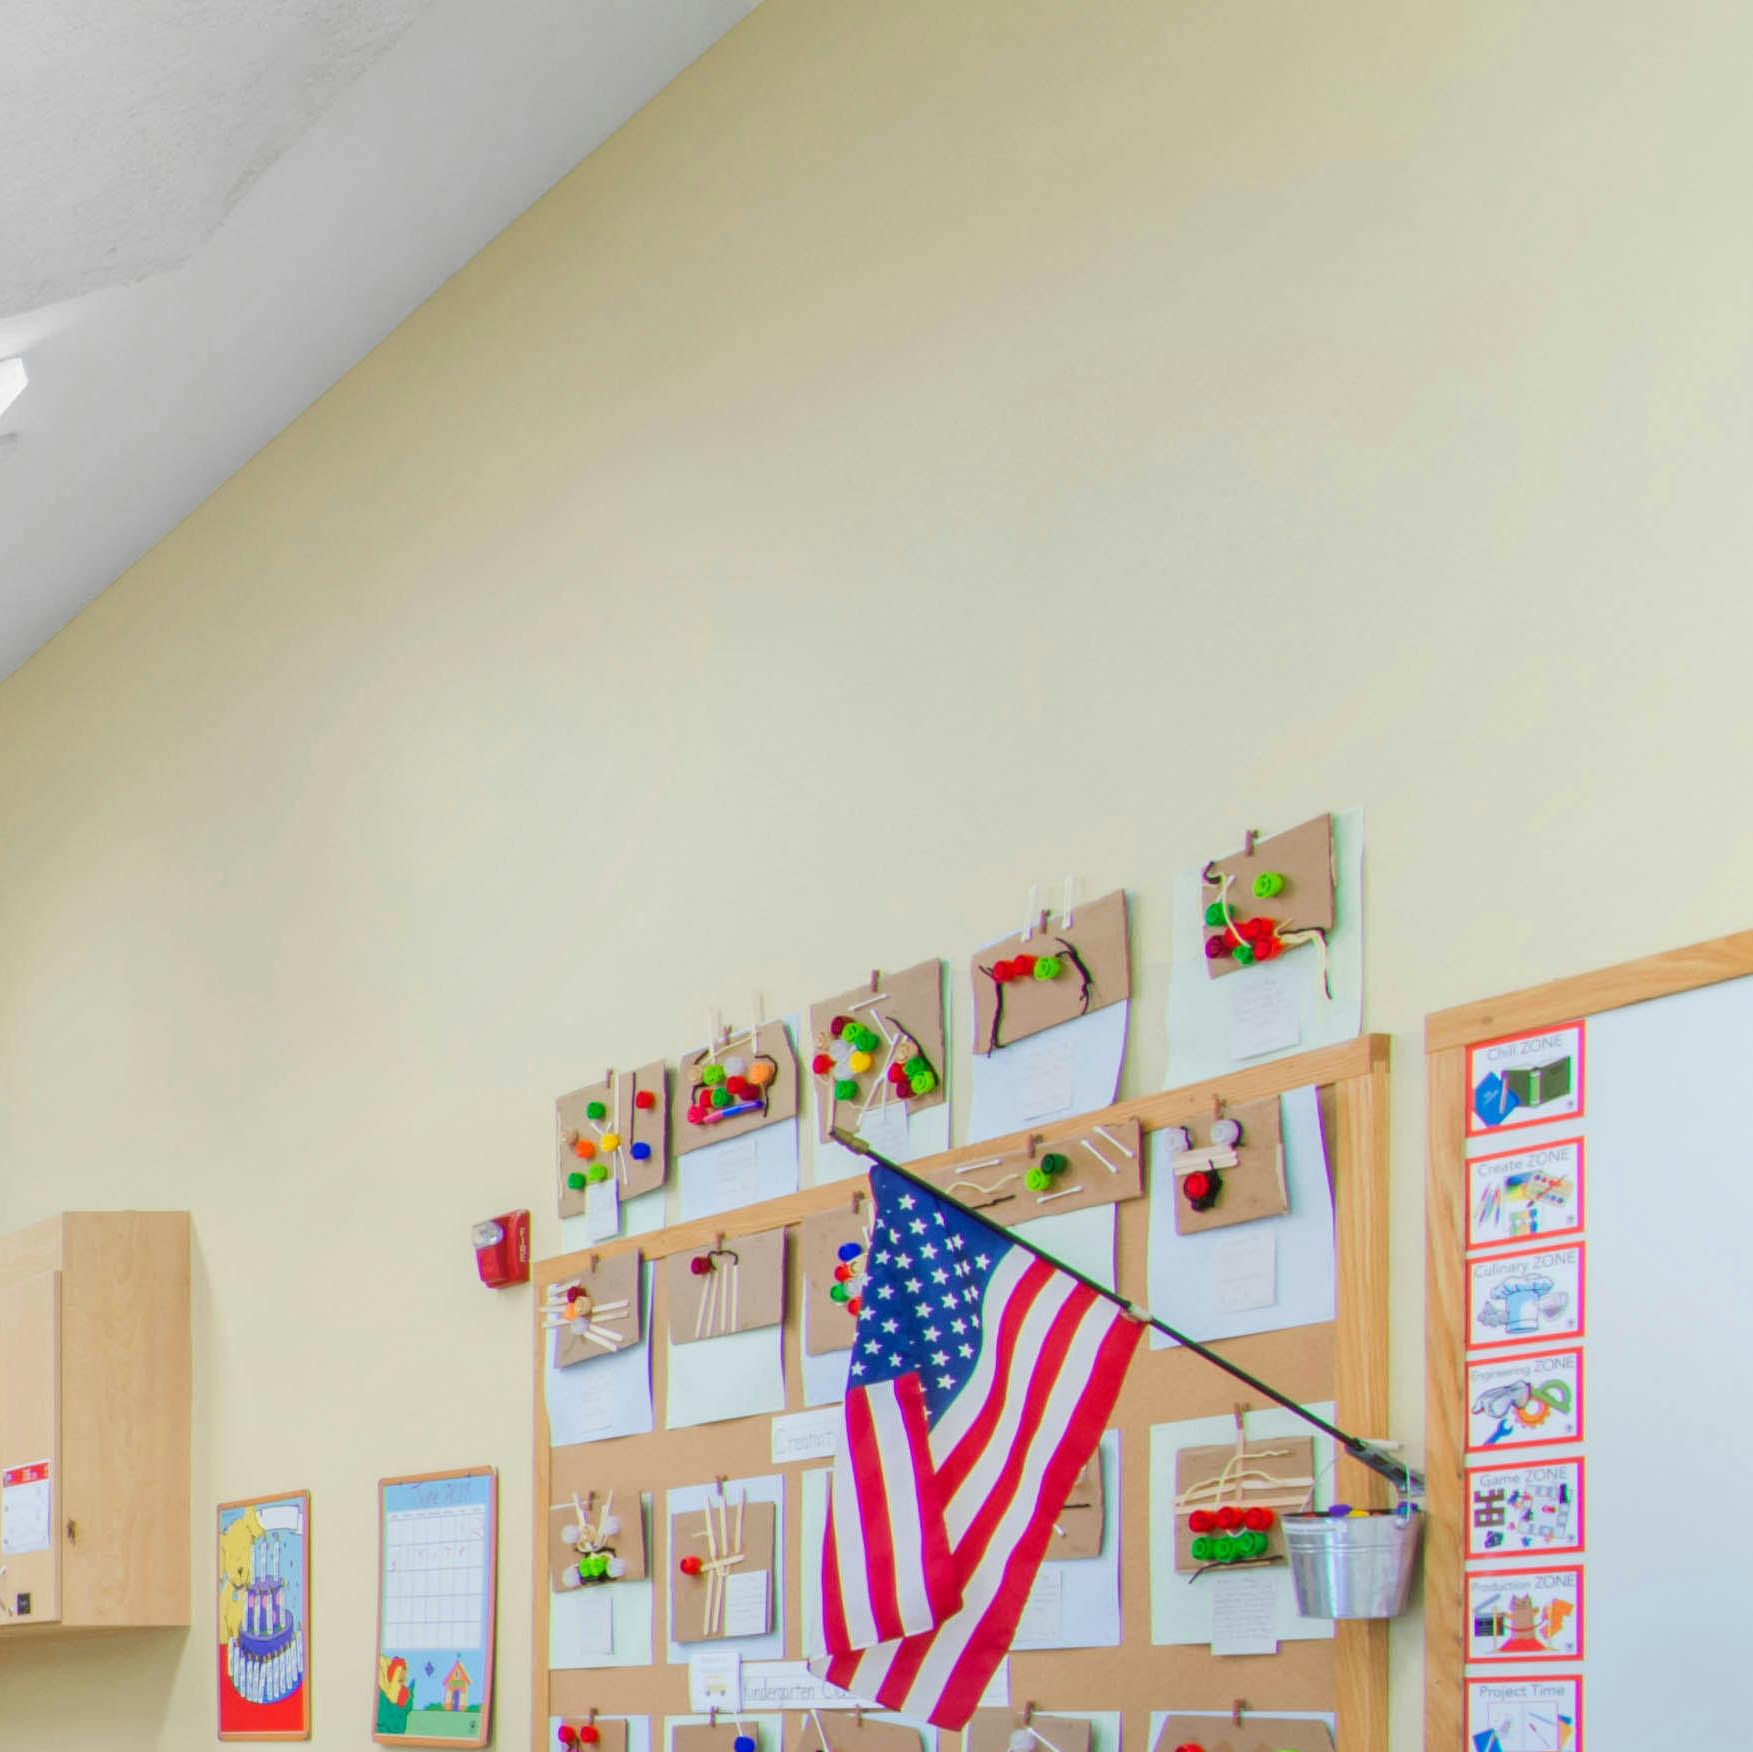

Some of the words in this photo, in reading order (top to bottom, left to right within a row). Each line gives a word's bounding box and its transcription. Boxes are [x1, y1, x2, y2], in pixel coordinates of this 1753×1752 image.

[1487, 1044, 1517, 1062] Chill
[1520, 1034, 1564, 1055] ZONE
[1477, 1156, 1523, 1177] Create
[1526, 1146, 1570, 1168] ZONE
[519, 1226, 528, 1263] FIRE
[1474, 1261, 1529, 1280] Culinary
[1532, 1250, 1576, 1270] ZONE
[1470, 1364, 1531, 1382] Engineering
[1534, 1354, 1575, 1373] ZONE
[1479, 1472, 1520, 1488] Game
[1523, 1465, 1567, 1483] ZONE
[1470, 1580, 1532, 1594] Production
[1534, 1573, 1577, 1590] ZONE
[1478, 1684, 1528, 1702] Project
[1529, 1683, 1566, 1697] Time
